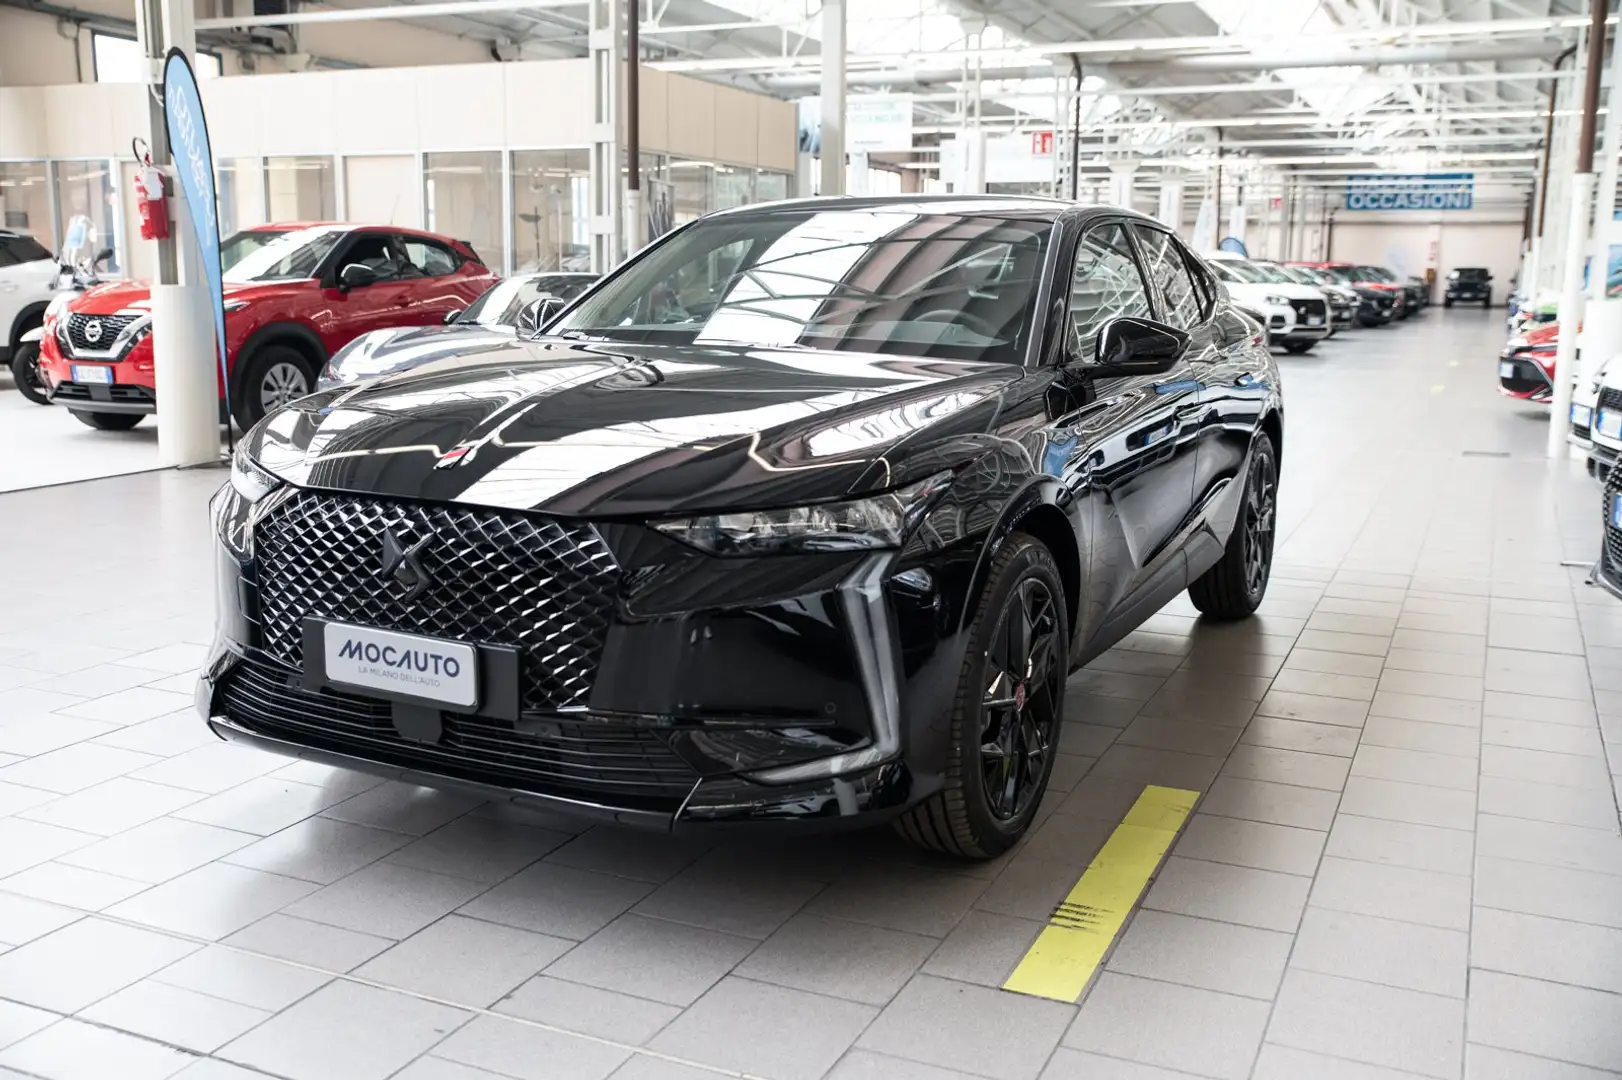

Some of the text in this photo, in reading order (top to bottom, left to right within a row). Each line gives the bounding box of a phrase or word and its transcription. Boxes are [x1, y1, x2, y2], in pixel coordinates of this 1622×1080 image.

[1350, 193, 1471, 208] OCCASIONI
[339, 639, 460, 678] MOCAUTO
[358, 665, 441, 688] LA MILANO DELL'AUTO
